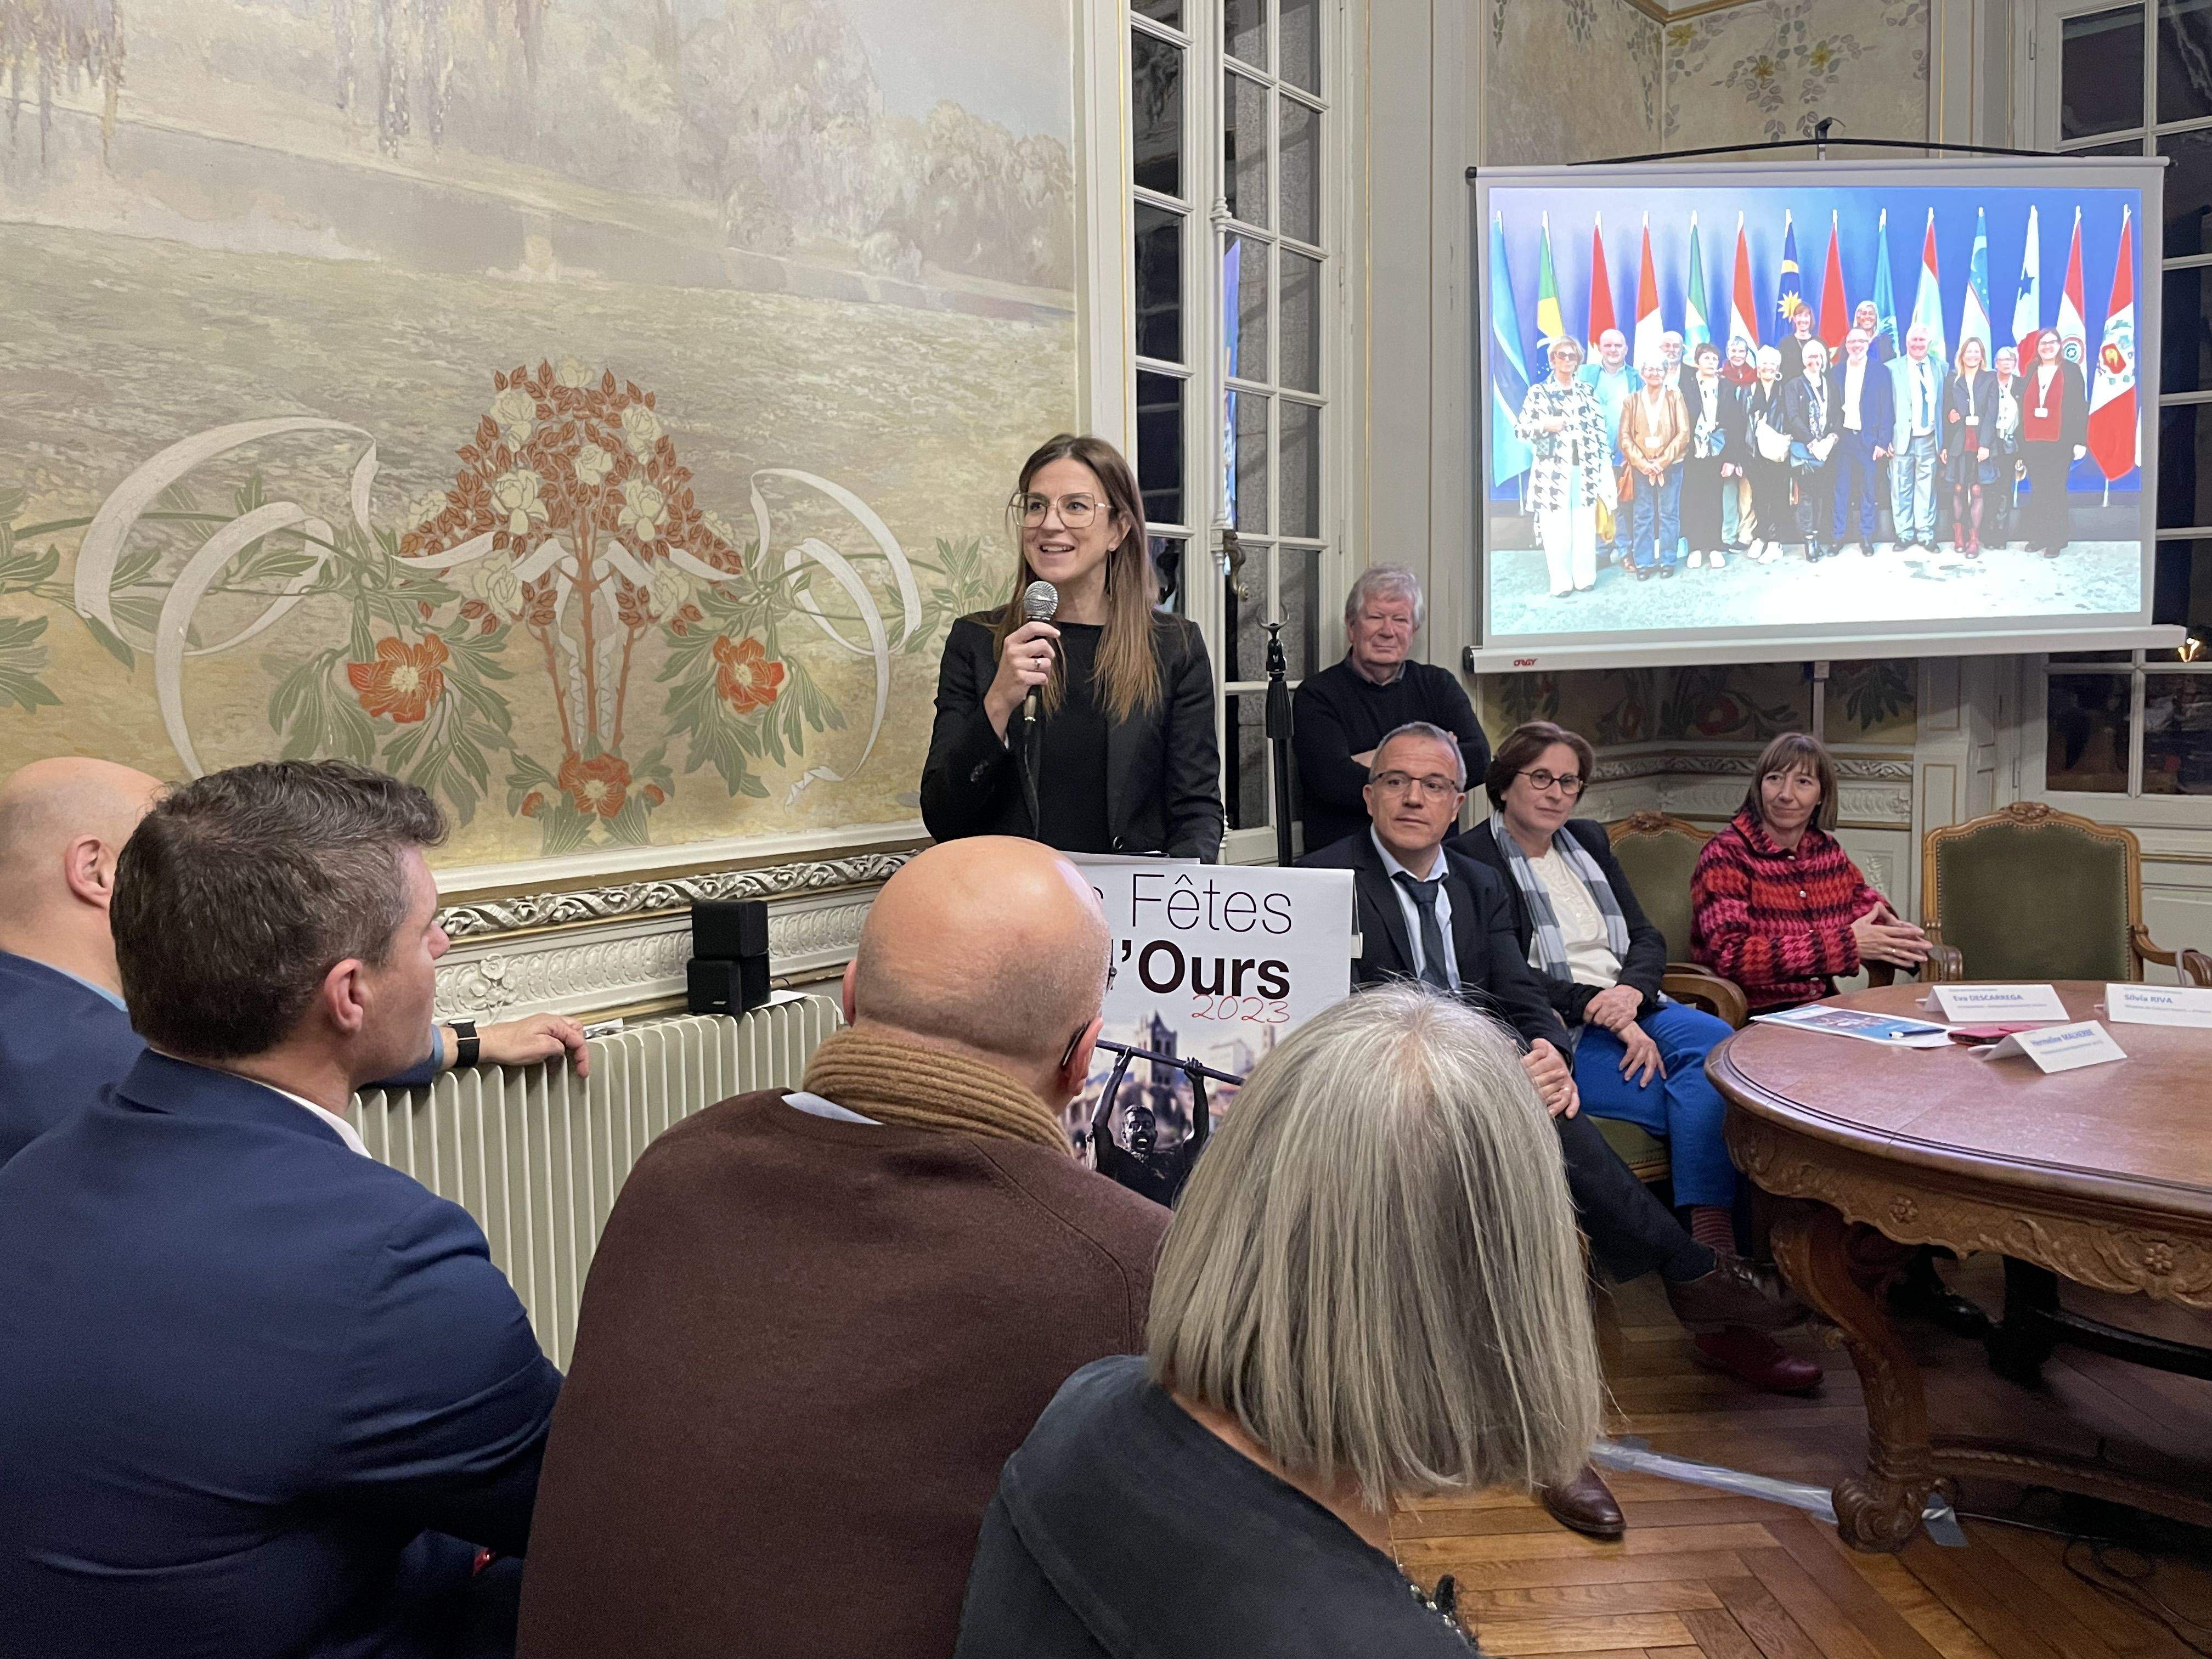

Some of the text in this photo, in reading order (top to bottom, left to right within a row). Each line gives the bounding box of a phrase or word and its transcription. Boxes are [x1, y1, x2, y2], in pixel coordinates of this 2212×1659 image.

[1132, 873, 1292, 934] Fêtes
[1110, 938, 1290, 1000] 'Ours
[1191, 994, 1290, 1023] 2023
